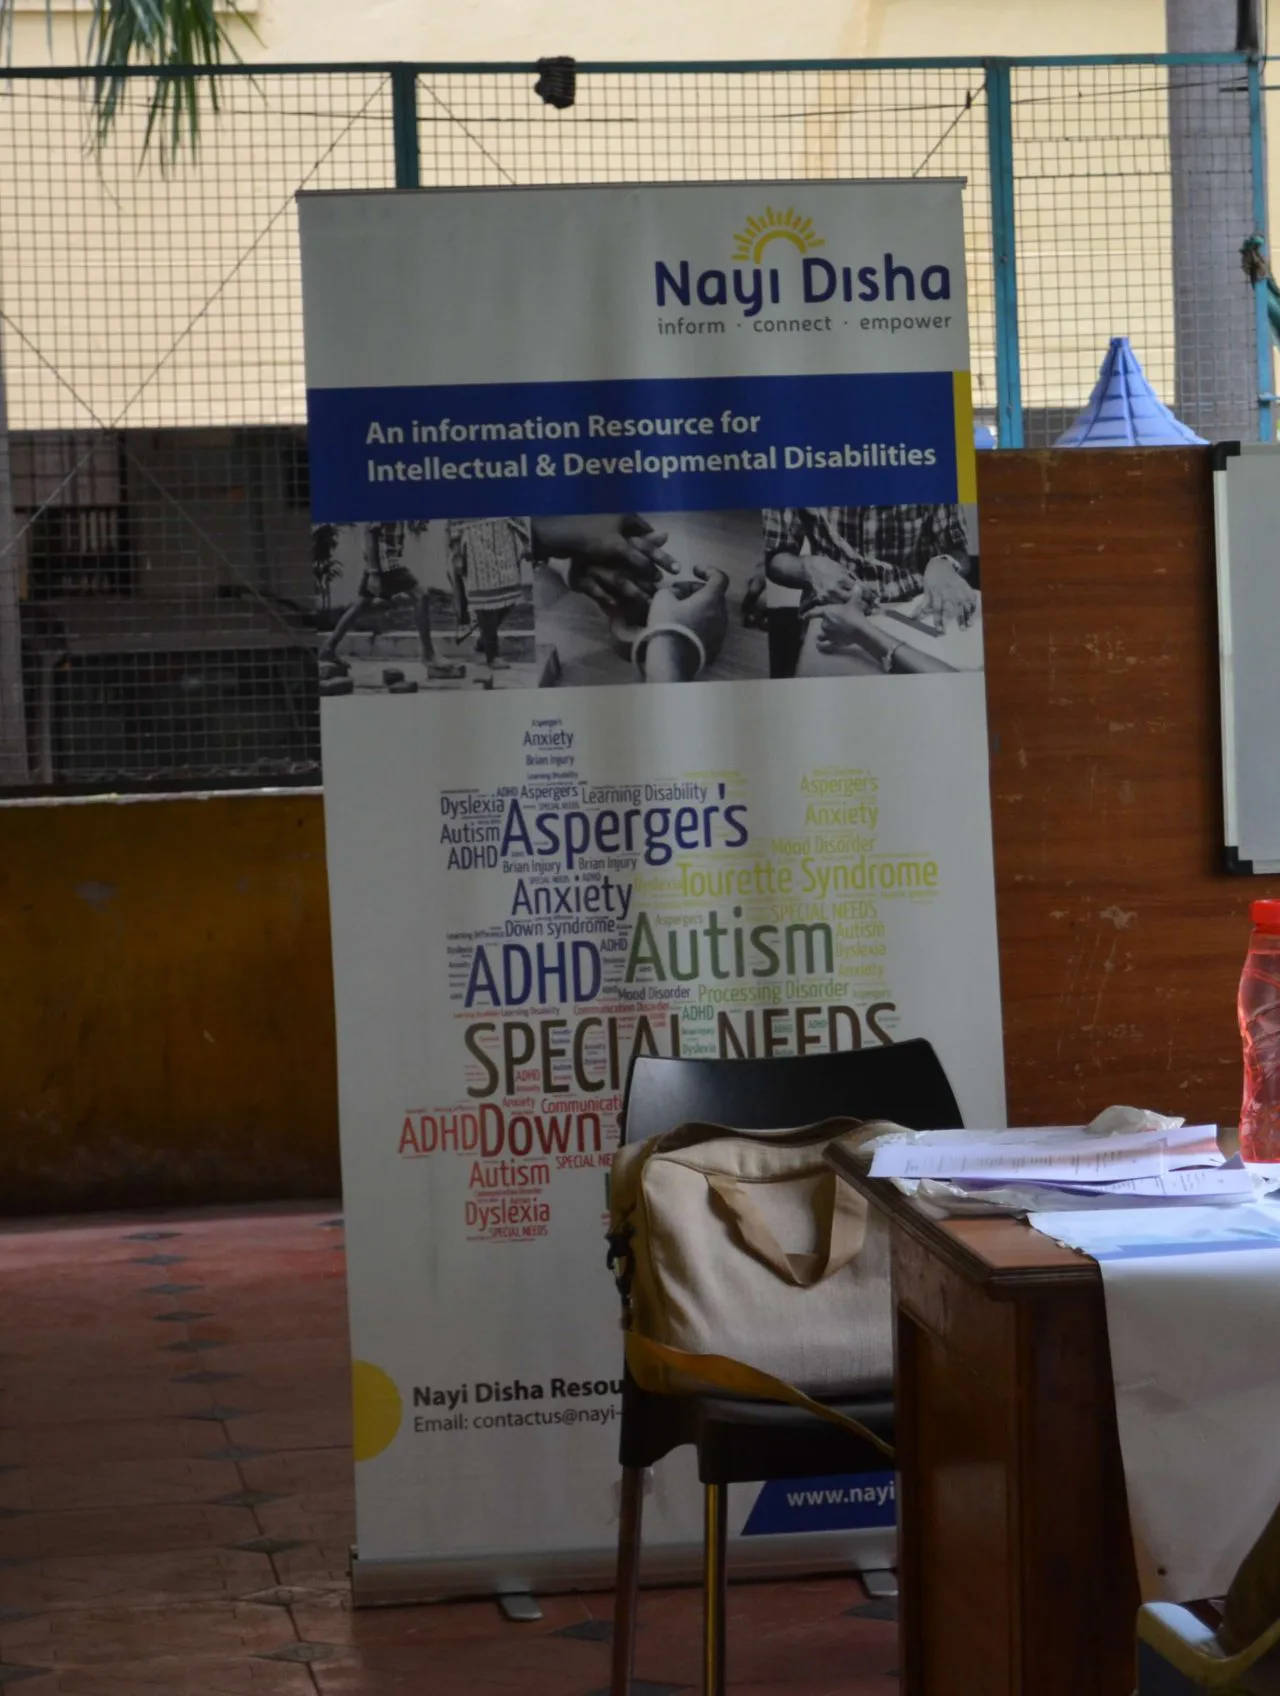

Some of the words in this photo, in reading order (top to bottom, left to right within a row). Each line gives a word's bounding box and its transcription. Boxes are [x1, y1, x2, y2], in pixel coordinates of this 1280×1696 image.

[655, 260, 780, 317] Nayi
[802, 253, 951, 304] Disha
[658, 318, 725, 335] inform
[753, 316, 832, 333] connect
[860, 314, 952, 335] empower
[366, 423, 404, 444] An
[412, 416, 580, 443] information
[589, 415, 714, 439] Resource
[721, 410, 760, 434] for
[368, 453, 527, 482] Intellectual
[535, 454, 557, 475] &
[565, 445, 777, 479] Developmental
[784, 443, 936, 469] Disabilities
[522, 729, 574, 749] Anxiety
[520, 784, 578, 801] Aspergers
[582, 786, 641, 806] Learning
[643, 784, 708, 804] Disability
[801, 772, 879, 798] Aspergers
[440, 794, 505, 820] Dyslexia
[805, 801, 879, 831] Anxiety
[440, 822, 501, 844] Autism
[500, 783, 749, 870] Asperger's
[448, 844, 499, 870] ADHD
[772, 840, 811, 856] Mood
[815, 836, 876, 855] Disorder
[503, 859, 530, 873] Brian
[531, 859, 561, 875] Injury
[578, 856, 606, 870] Brian
[607, 855, 637, 873] Injury
[675, 862, 792, 897] Tourette
[800, 855, 939, 900] Syndrome
[512, 875, 633, 921] Anxiety
[771, 902, 828, 924] SPECIAL
[832, 899, 879, 921] NEEDS
[505, 920, 543, 939] Down
[546, 916, 616, 940] syndrome
[600, 938, 628, 952] ADHD
[624, 907, 834, 984] Autism
[464, 940, 602, 1008] ADHD
[618, 986, 646, 1001] Mood
[647, 984, 690, 1000] Disorder
[698, 984, 782, 1004] Processing
[785, 979, 850, 1000] Disorder
[682, 1005, 714, 1021] ADHD
[515, 1069, 541, 1082] ADHD
[398, 1113, 479, 1154] ADHD
[478, 1102, 602, 1158] Down
[469, 1157, 551, 1188] Autism
[555, 1154, 596, 1170] SPECIAL
[465, 1197, 551, 1232] Dyslexia
[413, 1384, 468, 1411] Nayi
[475, 1378, 543, 1404] Disha
[414, 1411, 468, 1433] Email:
[786, 1480, 896, 1507] www.nayi
